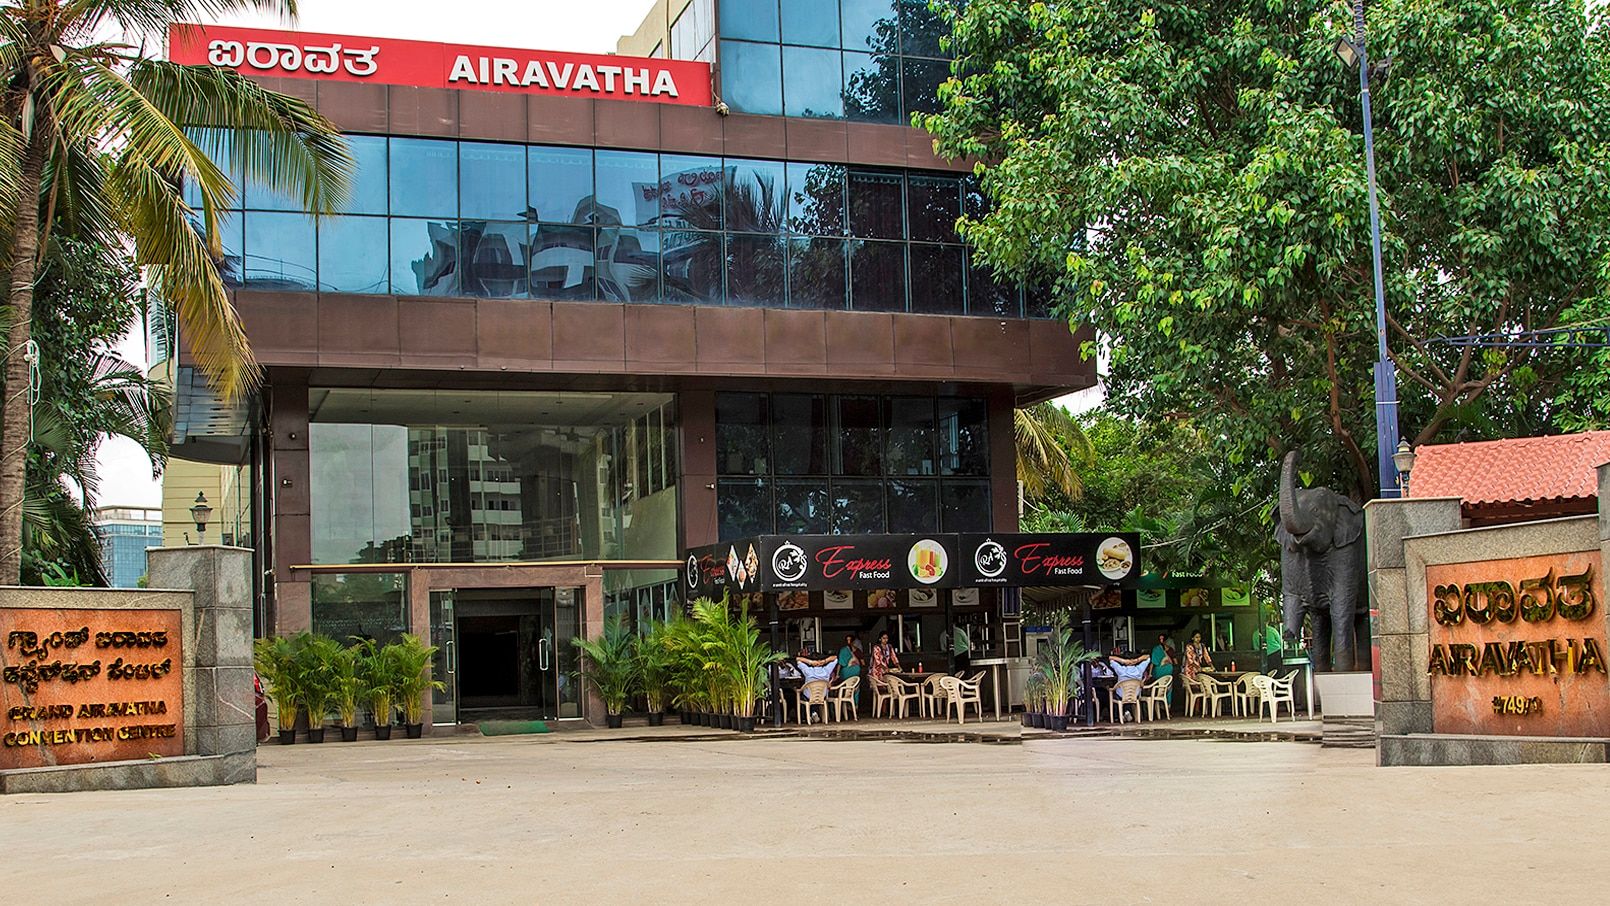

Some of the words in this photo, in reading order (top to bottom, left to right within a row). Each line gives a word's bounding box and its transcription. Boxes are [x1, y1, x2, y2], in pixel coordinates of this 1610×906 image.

[207, 38, 380, 77] ಐರಾವತ
[448, 54, 680, 98] AIRAVATHA
[815, 545, 891, 580] Express
[1013, 543, 1084, 576] Express
[1054, 567, 1067, 575] Fast
[1067, 567, 1083, 575] Food
[859, 571, 873, 579] Fast
[873, 571, 890, 579] Food
[1433, 563, 1596, 627] ಐರಾವತ
[95, 630, 169, 649] ಐರಾವತ
[8, 704, 74, 721] GRAND
[77, 700, 168, 720] AIRAVATHA
[3, 727, 115, 748] CONVENTION
[117, 723, 177, 741] CENTRE
